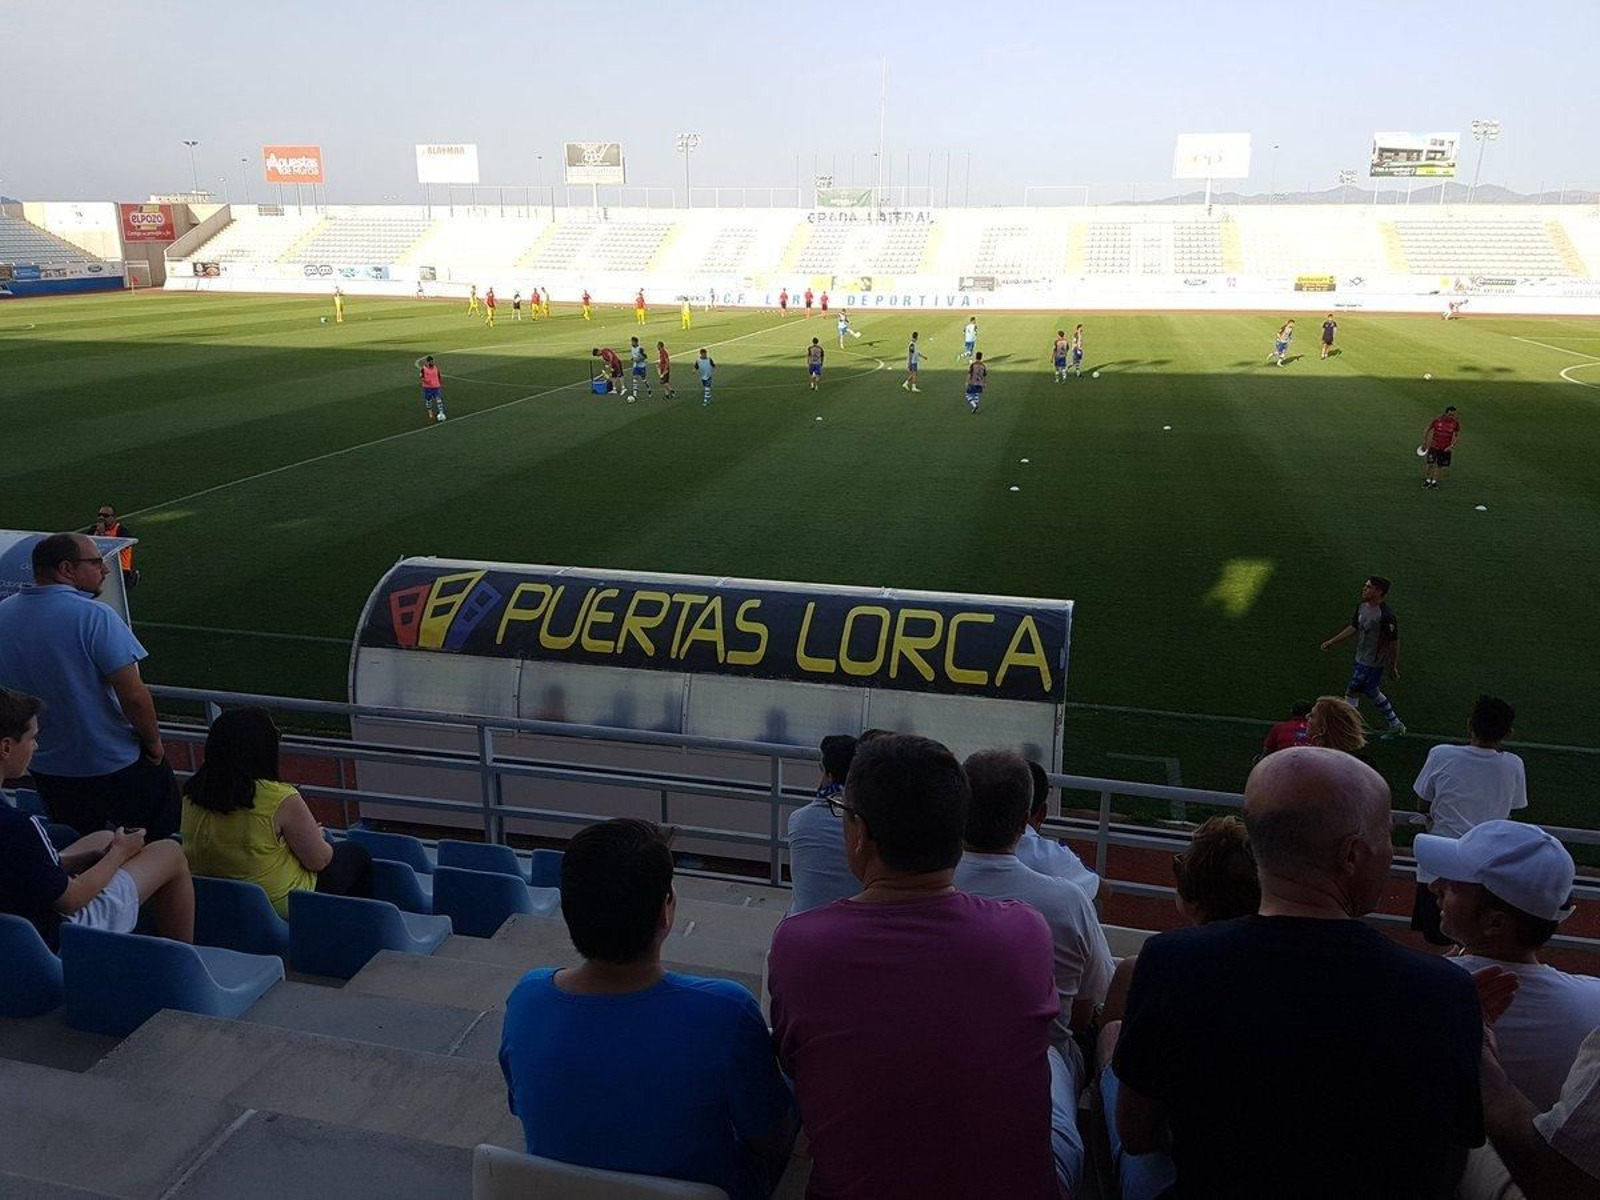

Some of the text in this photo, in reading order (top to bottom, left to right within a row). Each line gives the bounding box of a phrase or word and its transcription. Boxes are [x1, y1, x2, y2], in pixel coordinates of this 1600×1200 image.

[847, 294, 971, 306] DEPORTIVA
[496, 582, 1052, 692] PUERTAS LORCA
